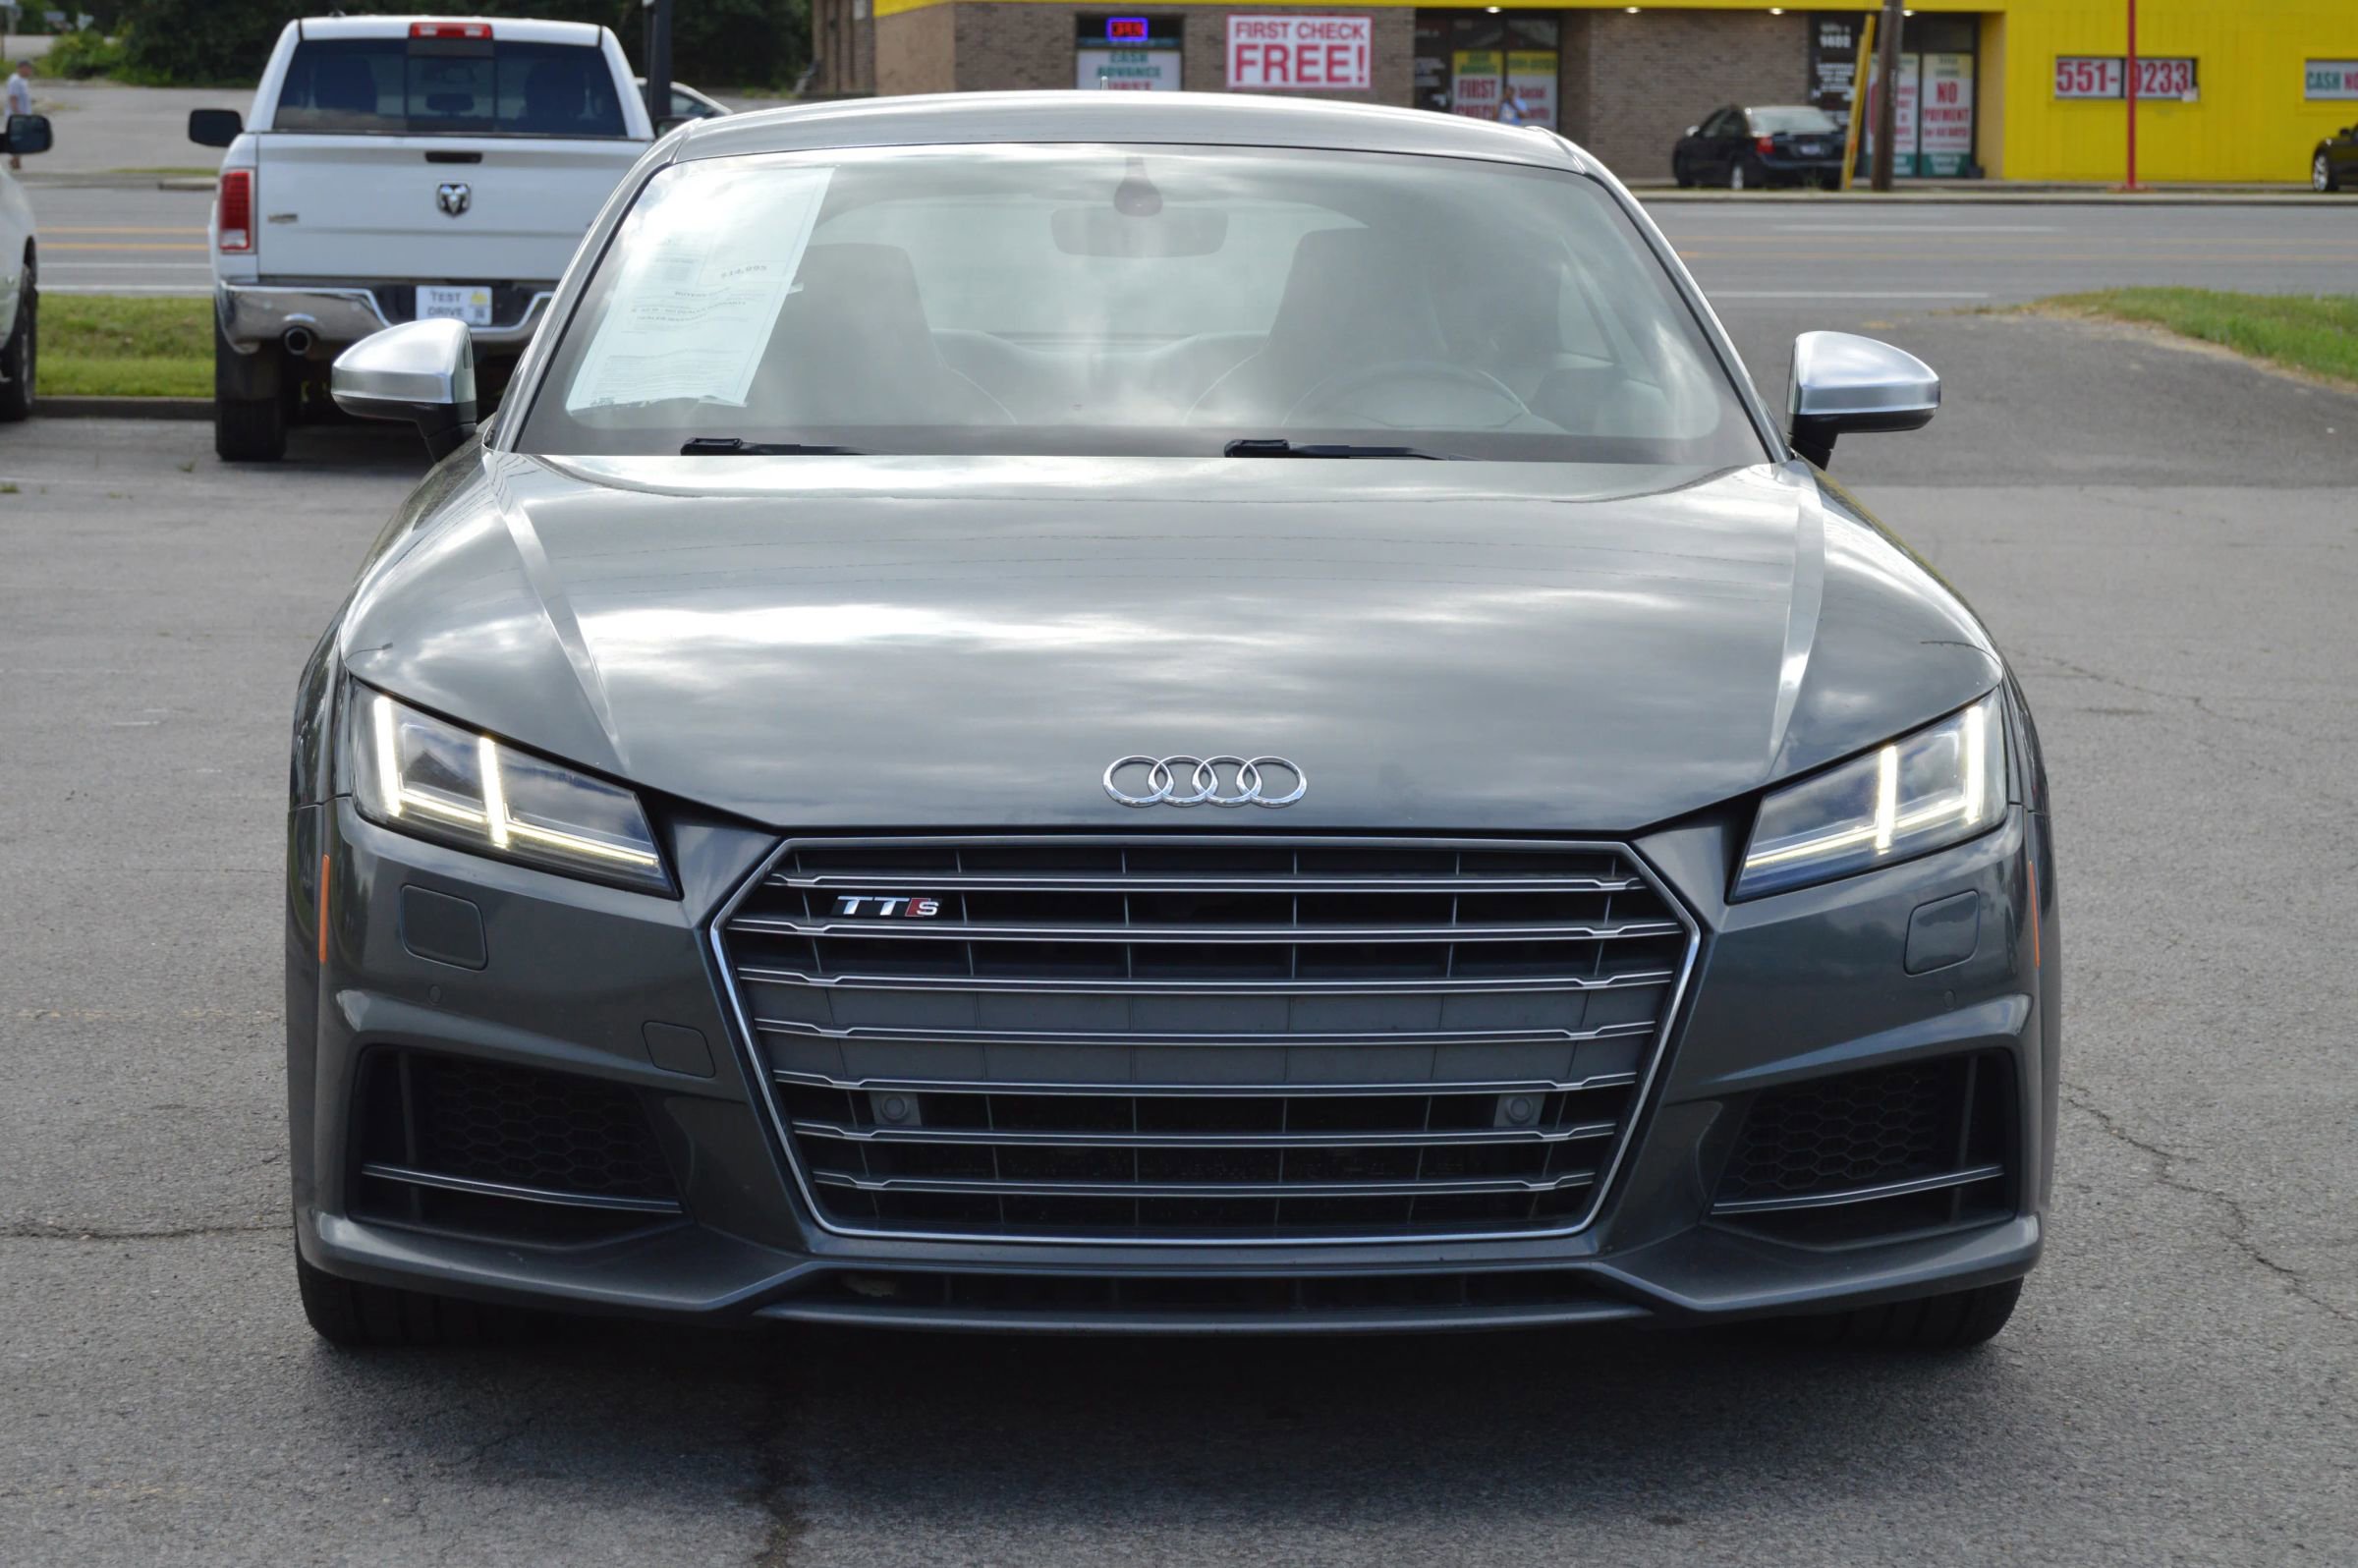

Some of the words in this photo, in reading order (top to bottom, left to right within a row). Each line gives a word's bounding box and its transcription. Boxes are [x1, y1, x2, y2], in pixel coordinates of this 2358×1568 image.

[1236, 22, 1290, 39] FIRST
[1296, 23, 1365, 40] CHECK
[1235, 43, 1366, 84] FREE!
[2306, 71, 2340, 90] CASH
[1937, 82, 1957, 104] NO
[429, 290, 461, 303] TEST
[427, 307, 464, 317] DRIVE
[837, 895, 940, 918] TTS
